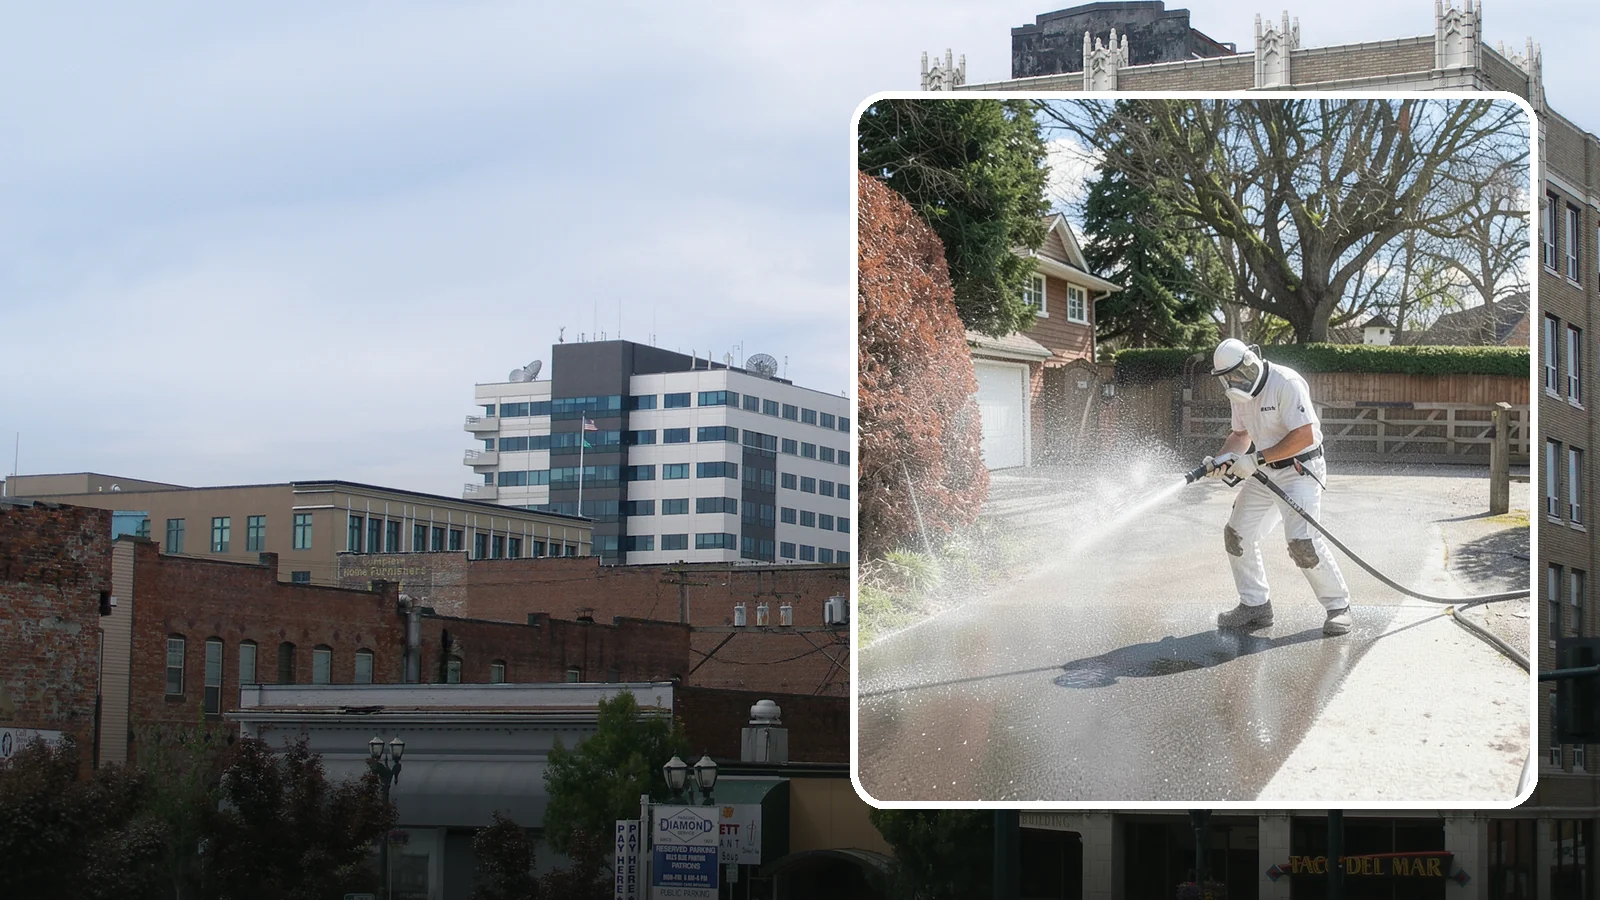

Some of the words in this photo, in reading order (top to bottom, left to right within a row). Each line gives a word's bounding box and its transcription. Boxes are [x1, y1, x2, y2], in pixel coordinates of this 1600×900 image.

[343, 567, 368, 577] Home
[370, 566, 427, 576] Furnishers
[660, 818, 713, 833] DIAMOND
[1022, 815, 1070, 828] BUILDING
[617, 825, 625, 852] PAY
[628, 824, 637, 852] PAY
[655, 845, 688, 853] RESERVED
[689, 846, 716, 854] PARKING
[721, 851, 739, 862] Soup
[671, 862, 701, 870] PATRONS
[1345, 856, 1385, 876] DEL
[1392, 857, 1443, 877] MAR
[616, 856, 625, 893] HERE
[627, 856, 636, 893] HERE
[660, 888, 682, 898] PUBLIC
[683, 889, 710, 898] PARKING
